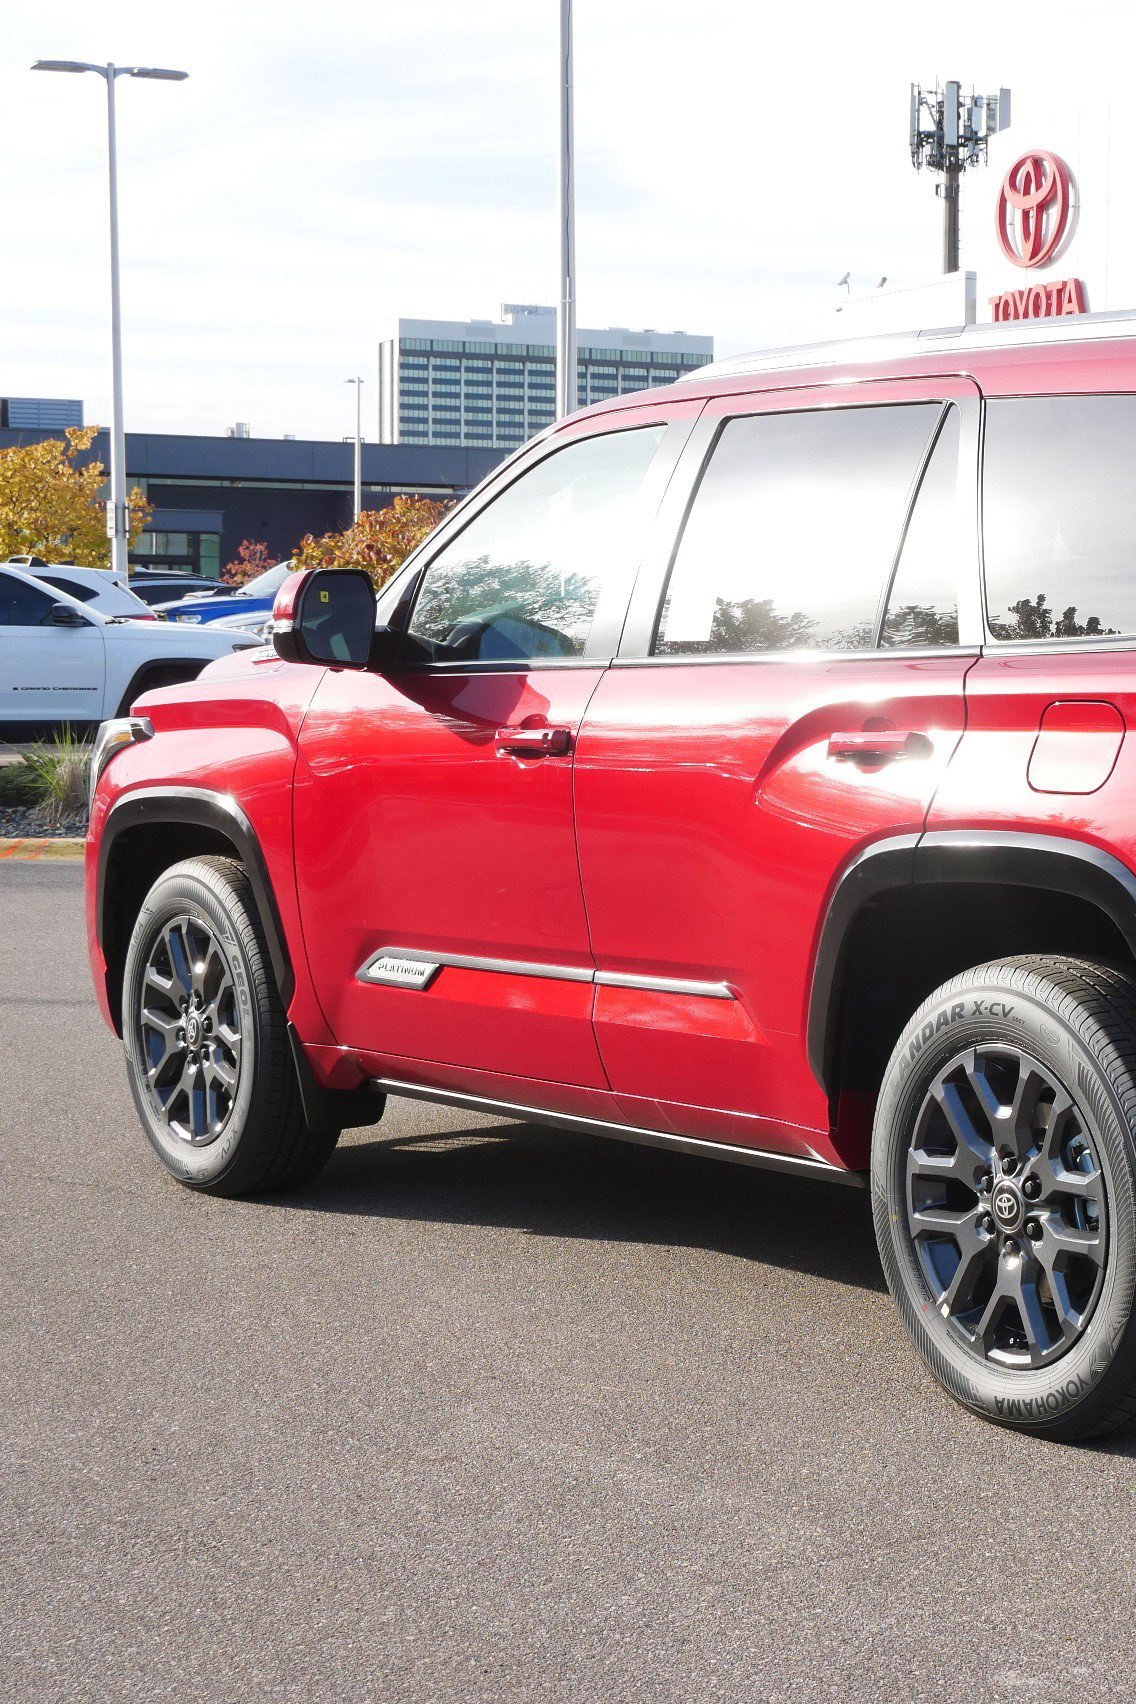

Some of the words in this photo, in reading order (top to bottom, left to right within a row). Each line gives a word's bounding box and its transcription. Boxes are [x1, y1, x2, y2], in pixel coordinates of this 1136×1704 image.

[988, 278, 1085, 323] TOYOTA
[378, 962, 426, 977] PLATINUM
[971, 1000, 1015, 1019] X-CV
[993, 1372, 1090, 1418] YOKOHAMA
